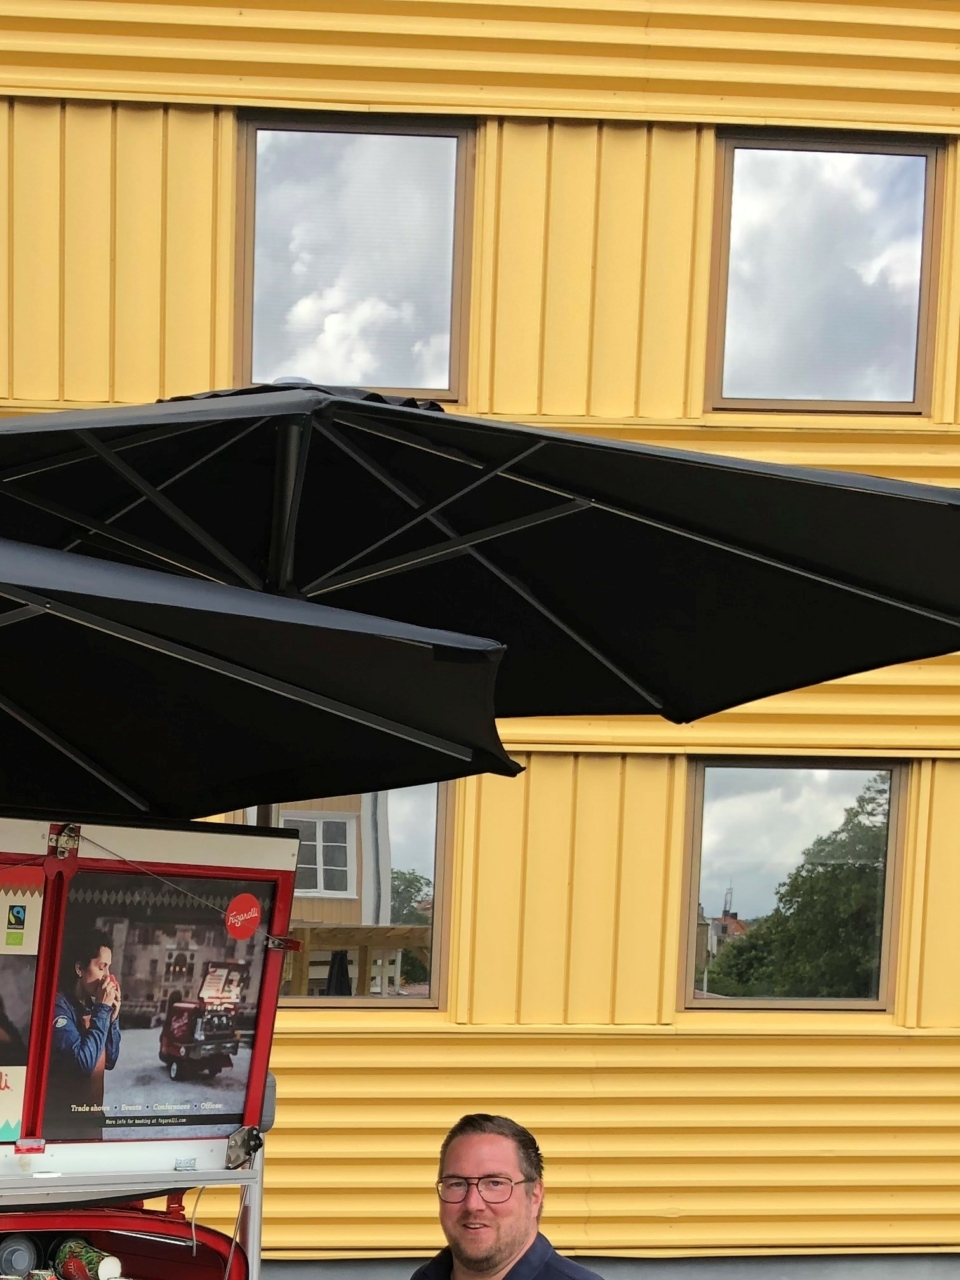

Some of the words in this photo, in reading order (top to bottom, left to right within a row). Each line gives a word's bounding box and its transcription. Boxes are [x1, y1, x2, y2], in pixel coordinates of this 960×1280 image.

[227, 907, 259, 927] Fogarolli
[71, 1104, 90, 1112] Trade
[90, 1104, 110, 1112] shows
